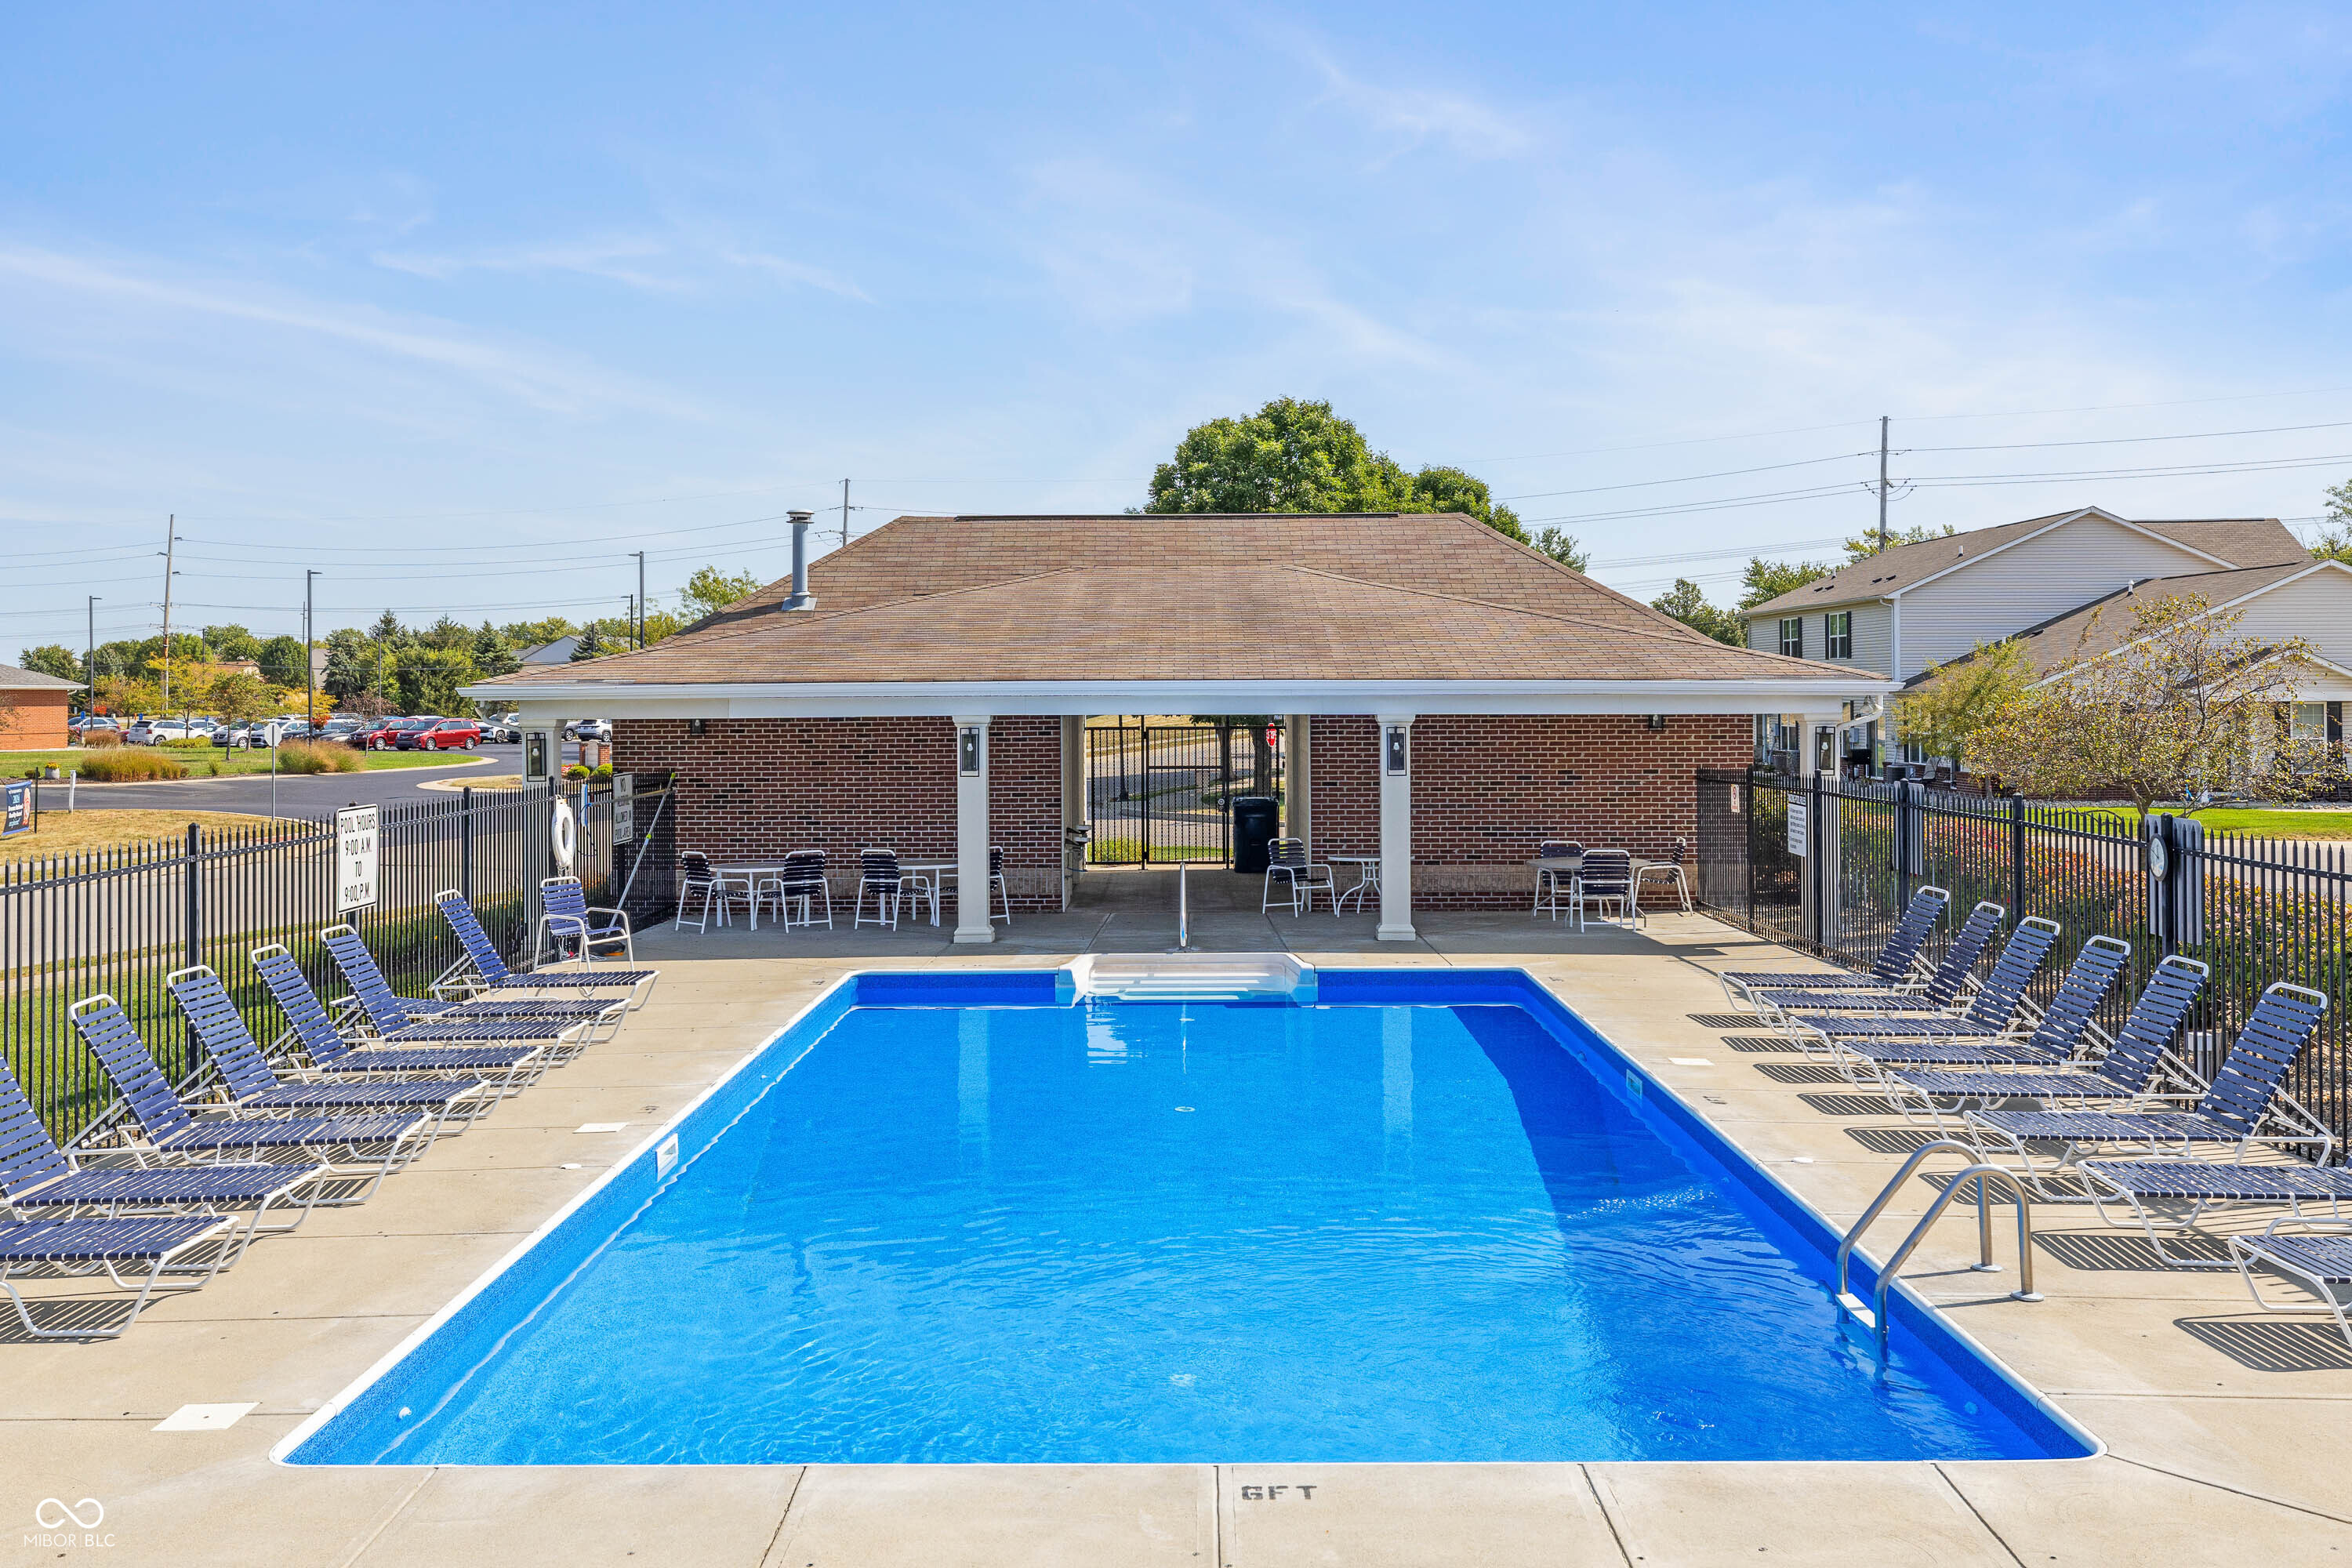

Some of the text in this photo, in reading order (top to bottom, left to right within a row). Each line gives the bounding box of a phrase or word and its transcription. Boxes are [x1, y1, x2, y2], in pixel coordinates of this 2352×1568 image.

[340, 814, 376, 834] POOL HOURS
[345, 837, 372, 856] 9:00 A.M.
[355, 861, 361, 877] TO
[345, 882, 371, 902] 9:00 P.M.
